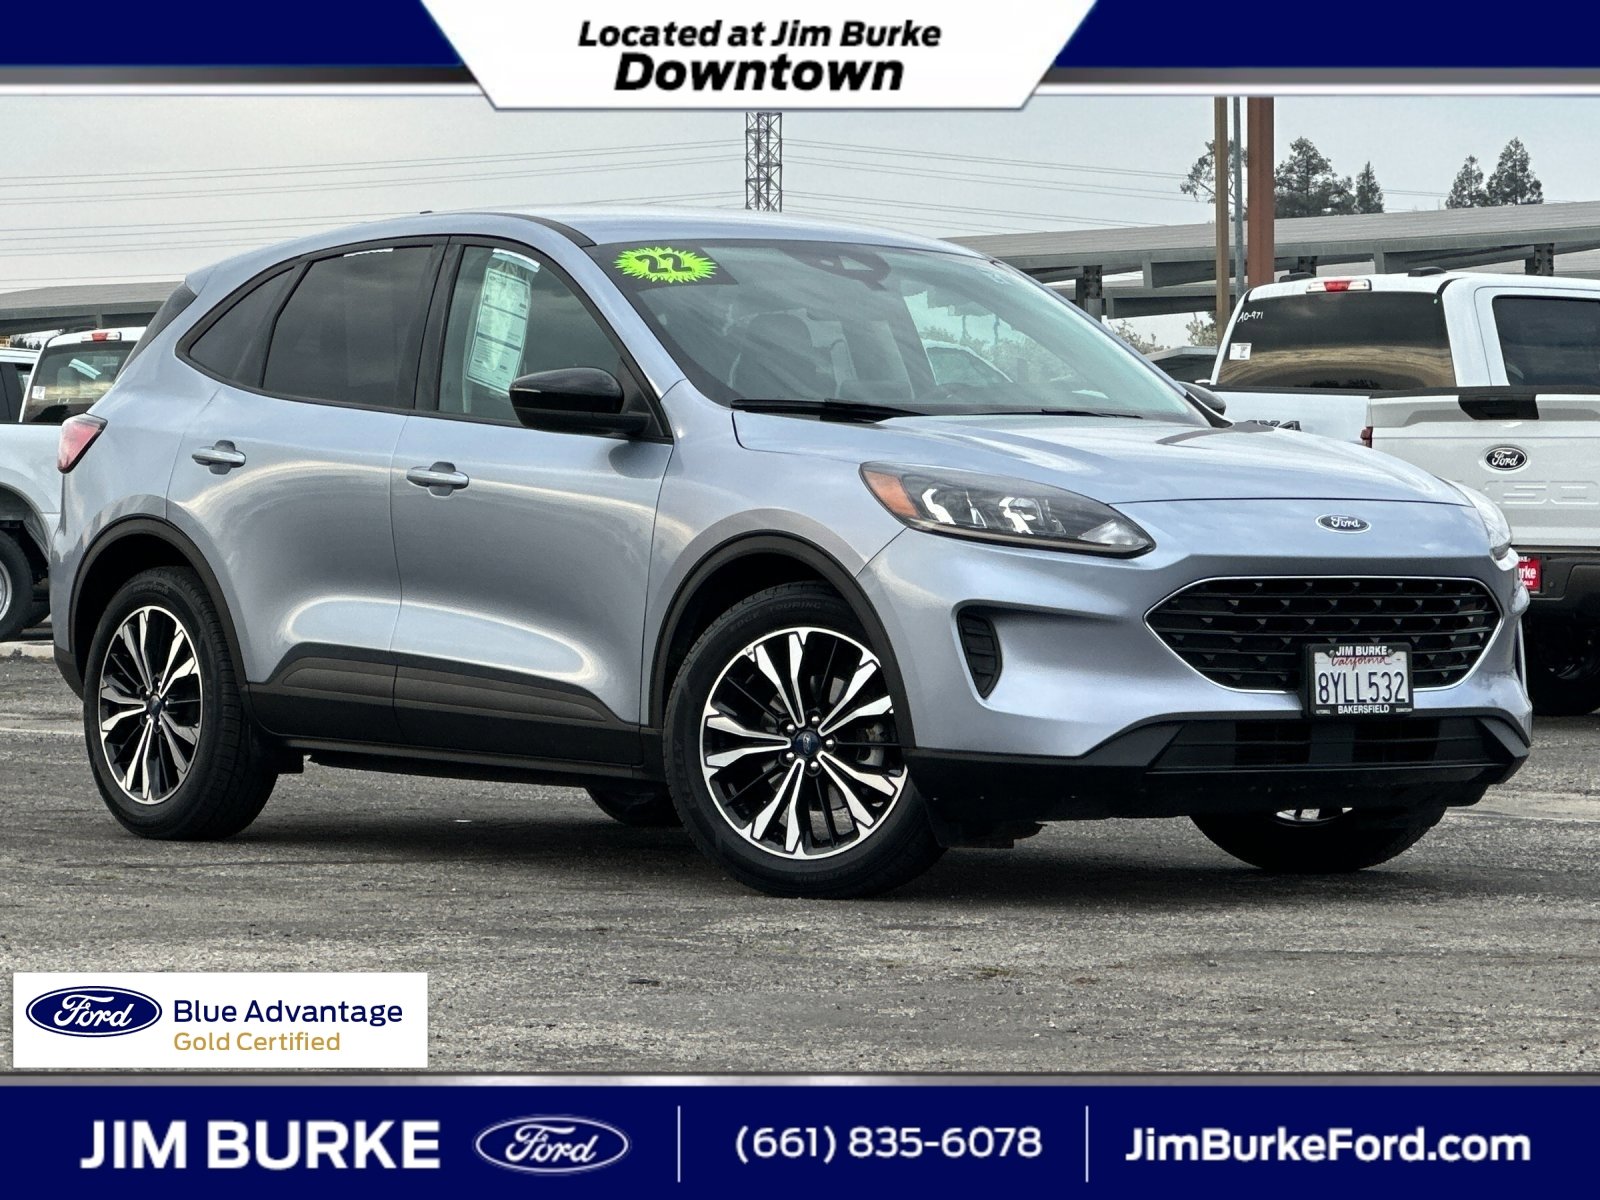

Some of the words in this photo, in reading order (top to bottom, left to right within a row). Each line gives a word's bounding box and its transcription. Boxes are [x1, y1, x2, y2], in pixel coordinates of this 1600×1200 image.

[634, 253, 693, 273] 22
[1491, 450, 1519, 466] Ford
[1330, 516, 1361, 528] Ford
[1336, 646, 1353, 656] JIM
[1355, 645, 1388, 656] BURKE
[1318, 671, 1406, 704] 8YLL532
[1338, 704, 1390, 714] BAKERSFIELD
